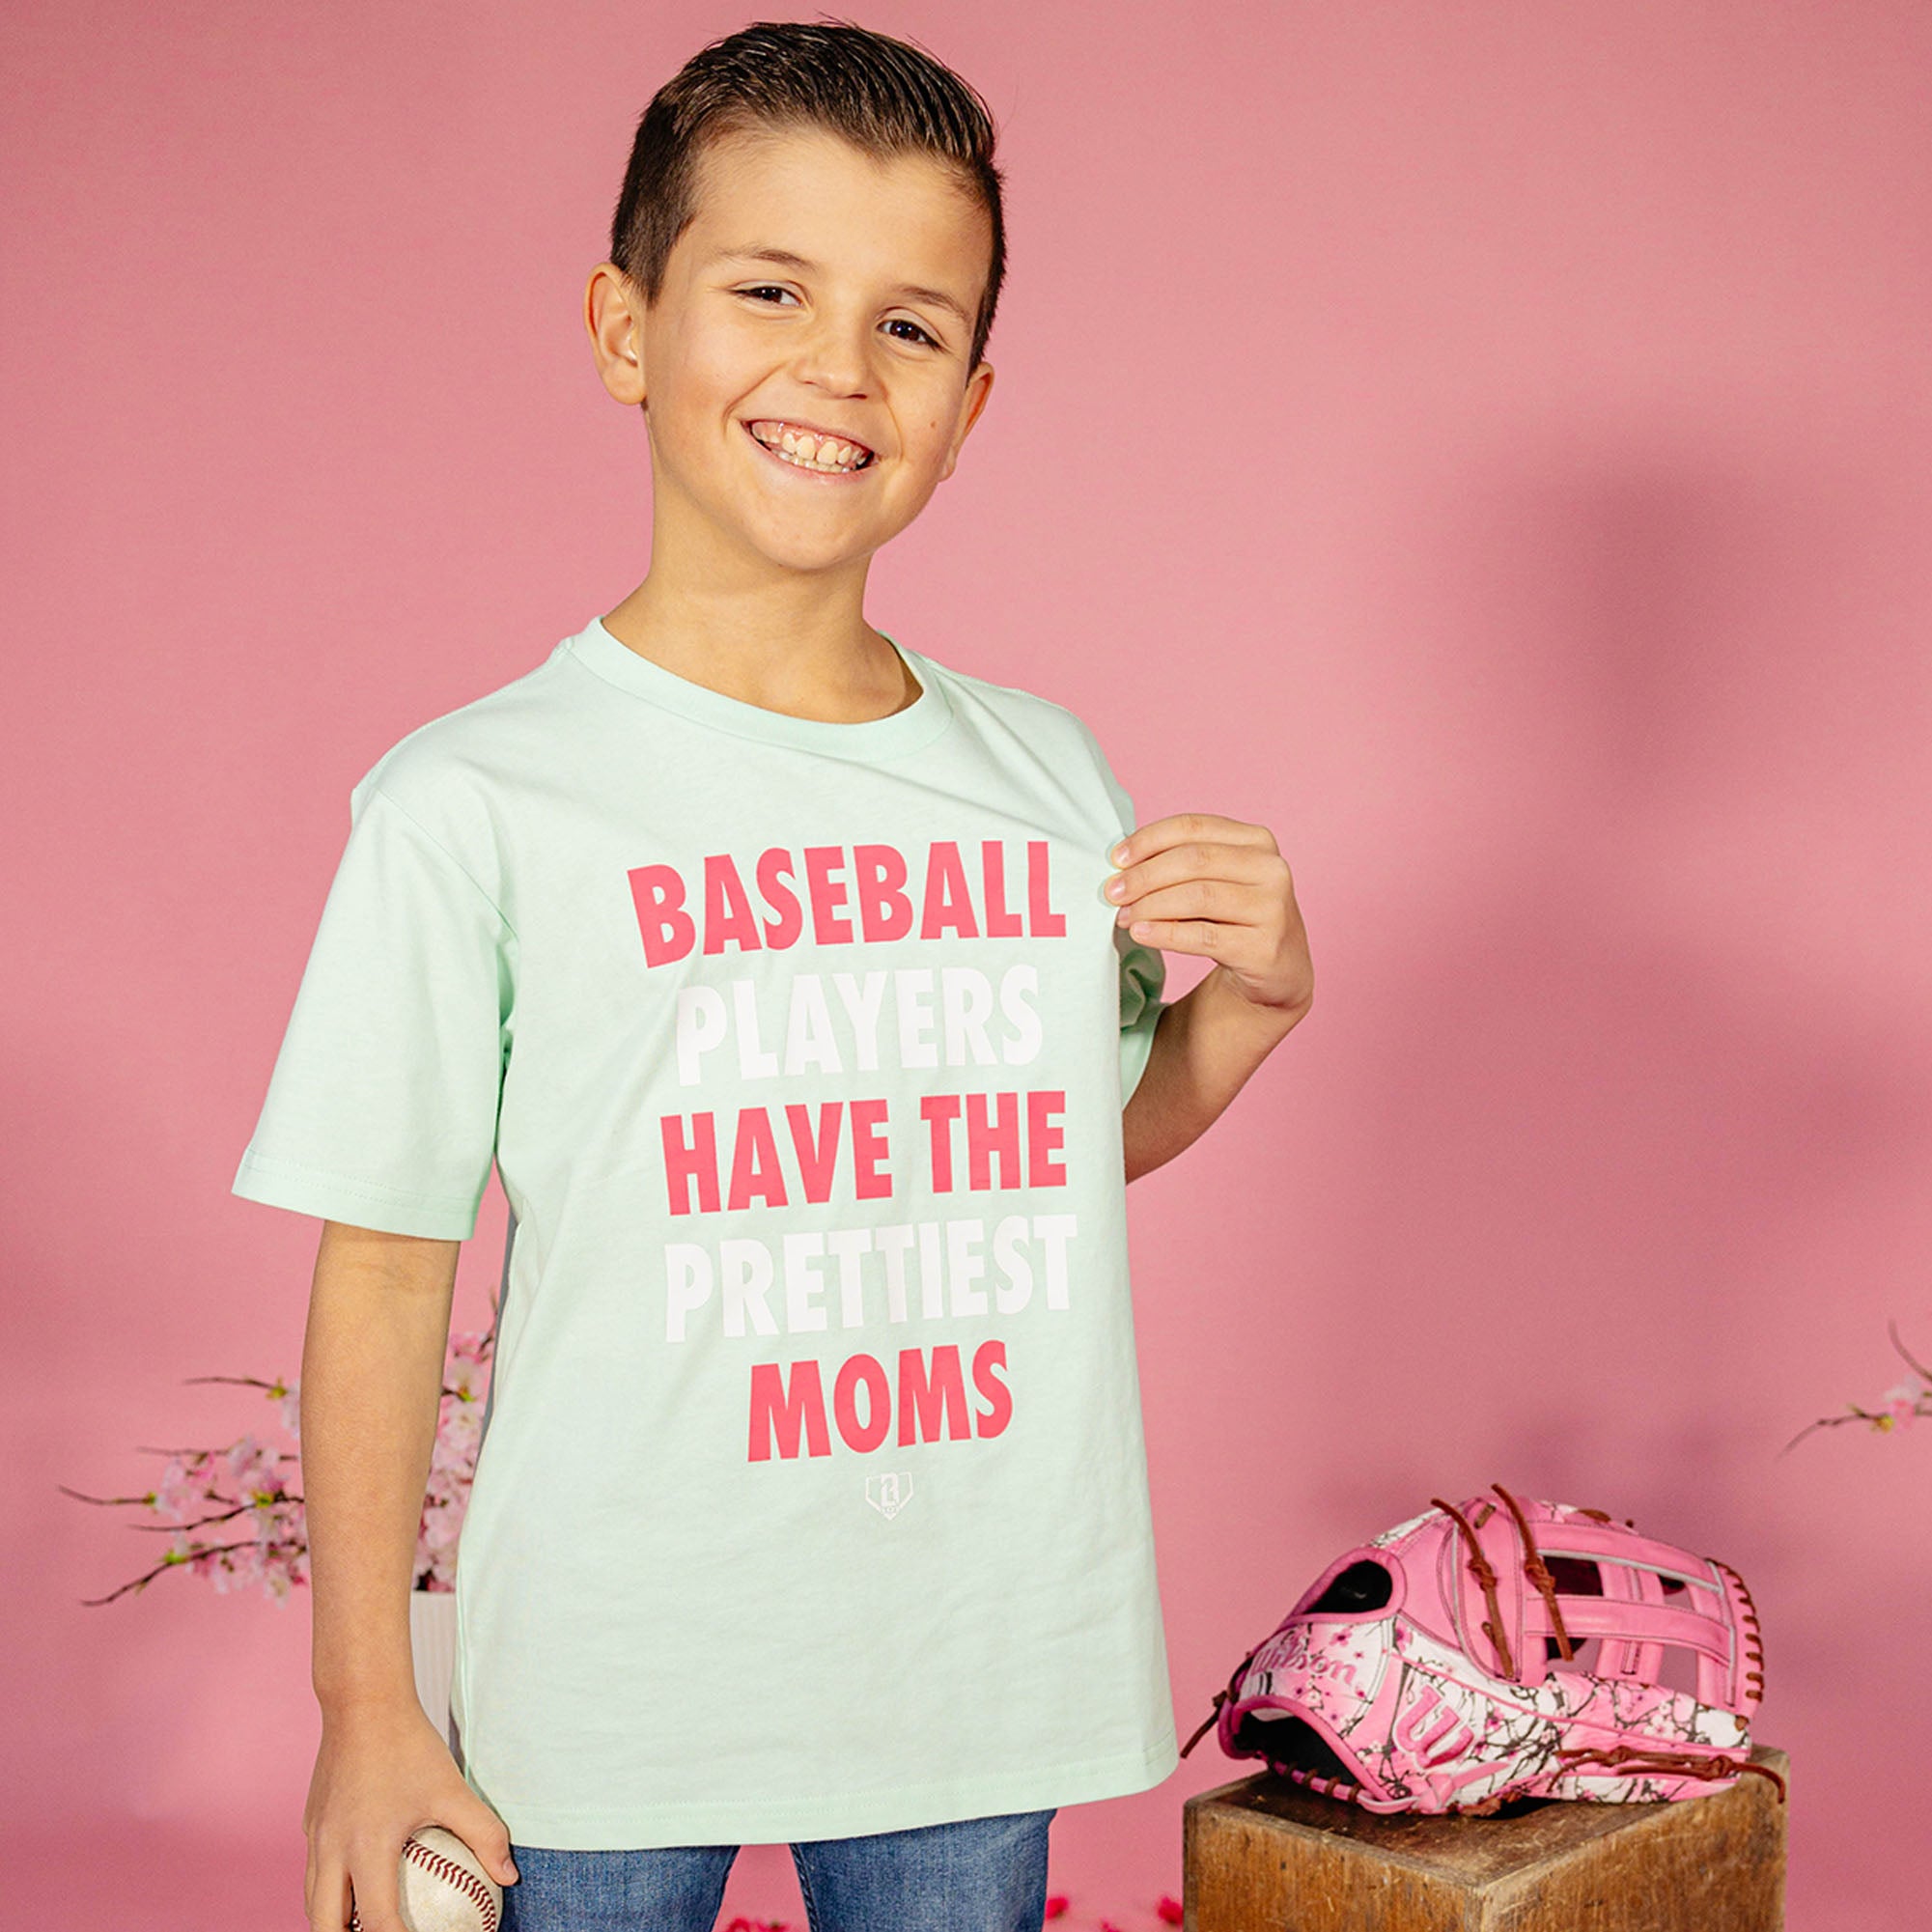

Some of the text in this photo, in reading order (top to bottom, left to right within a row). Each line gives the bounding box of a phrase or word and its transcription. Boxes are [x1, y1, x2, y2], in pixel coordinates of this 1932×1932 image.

[628, 840, 1067, 968] BASEBALL
[675, 964, 1044, 1086] PLAYERS
[660, 1091, 1067, 1217] HAVE THE
[663, 1214, 1078, 1344] PRETTIEST
[747, 1339, 1013, 1463] MOMS
